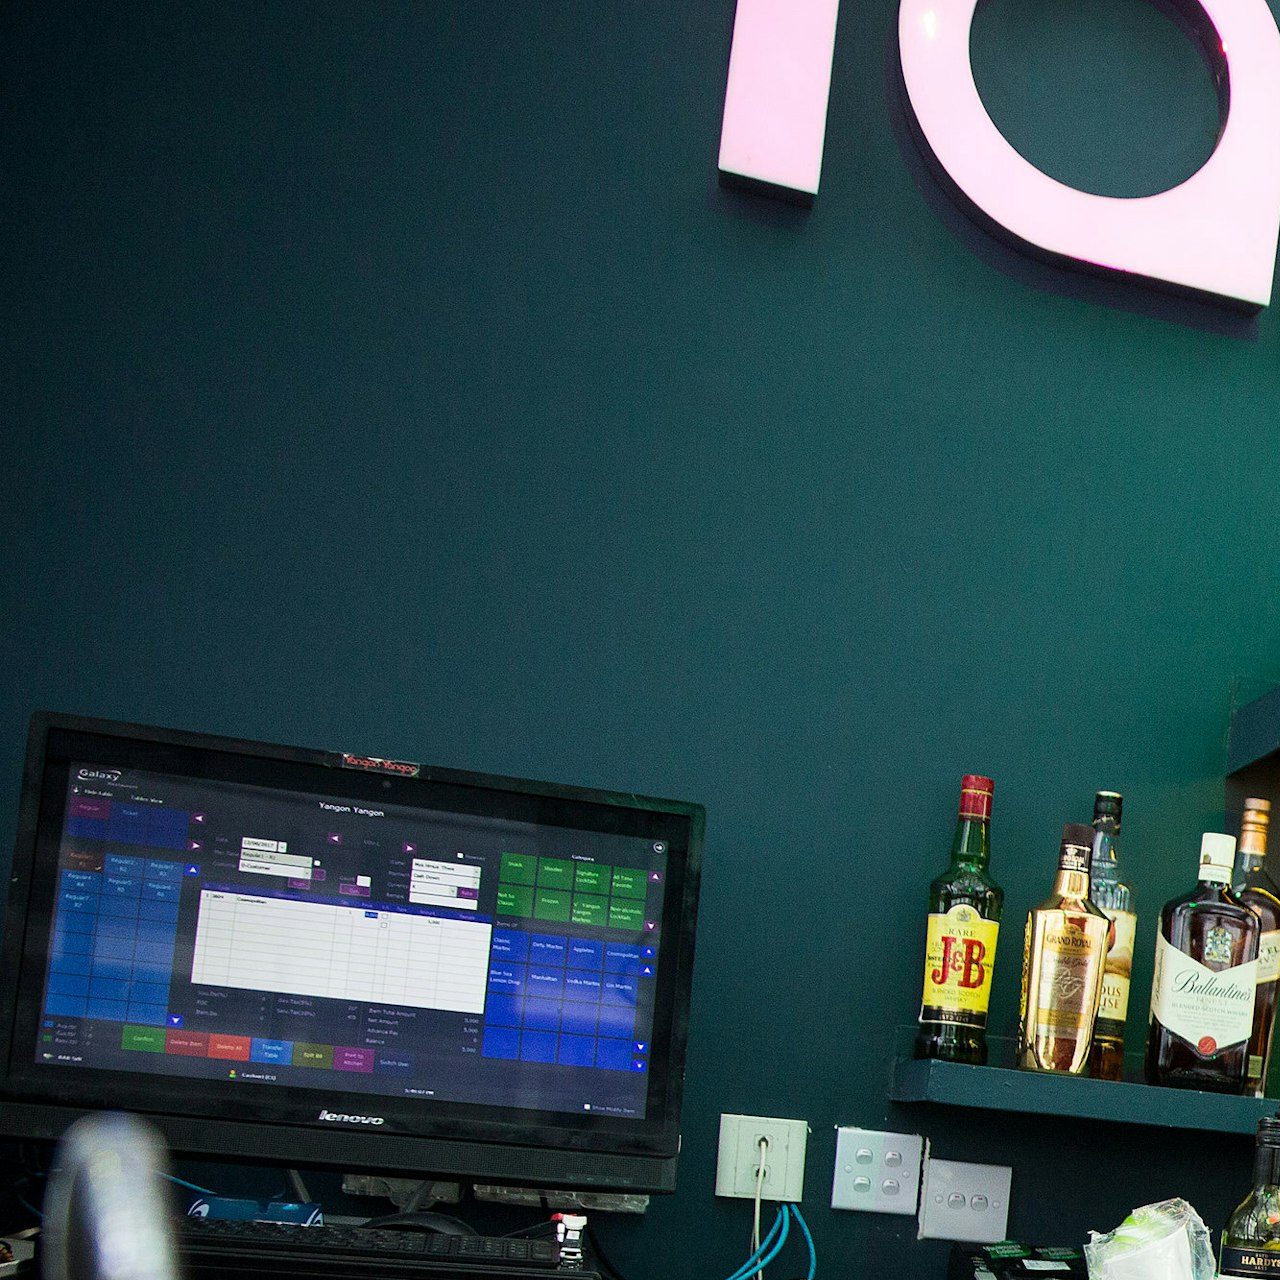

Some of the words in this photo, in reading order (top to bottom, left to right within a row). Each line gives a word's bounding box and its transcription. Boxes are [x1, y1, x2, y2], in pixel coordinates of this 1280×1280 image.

[346, 754, 382, 769] Yangon
[79, 768, 121, 781] Galaxy
[319, 802, 351, 814] Yangon
[353, 806, 385, 818] Yangon
[948, 928, 976, 937] RARE
[1047, 935, 1071, 948] GRAND
[1071, 937, 1092, 949] ROYAL
[931, 936, 986, 989] J&B
[1171, 968, 1251, 1001] Ballantine's
[319, 1109, 385, 1126] lenovo
